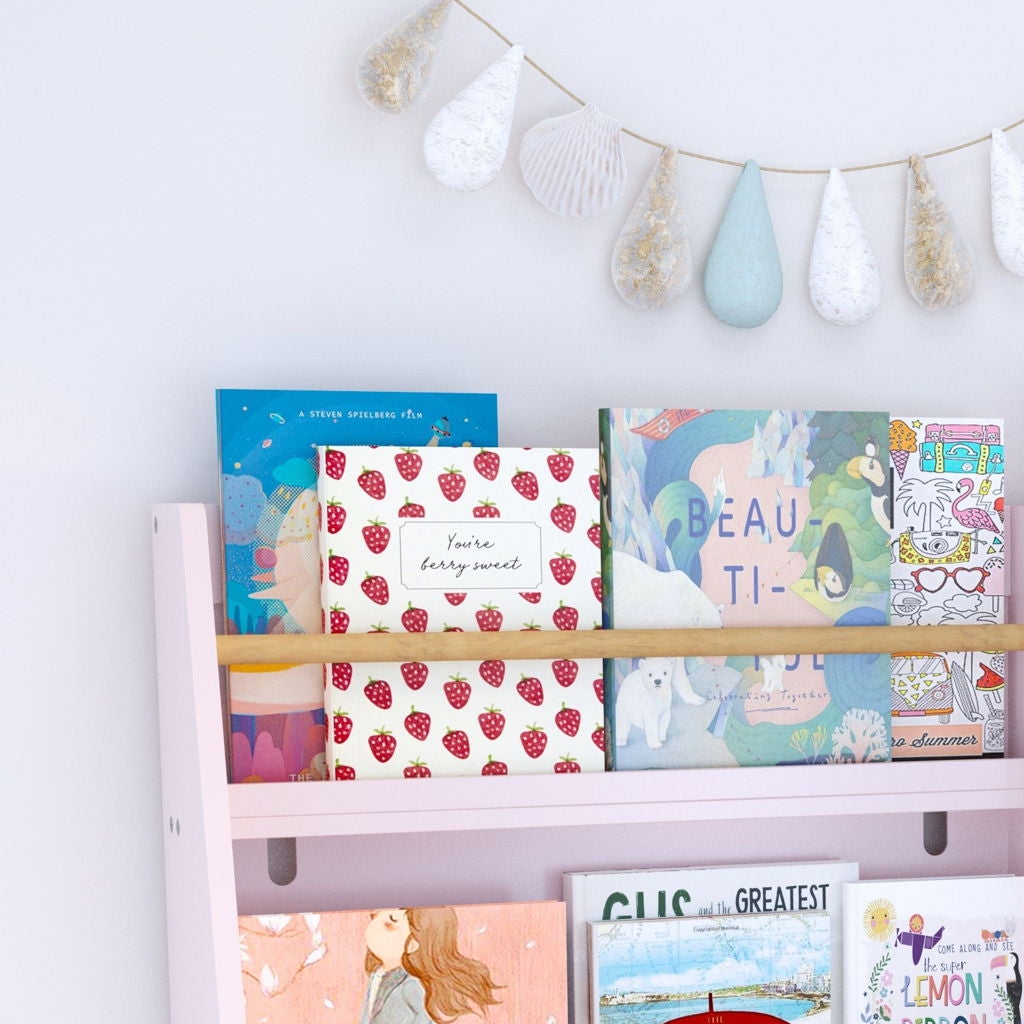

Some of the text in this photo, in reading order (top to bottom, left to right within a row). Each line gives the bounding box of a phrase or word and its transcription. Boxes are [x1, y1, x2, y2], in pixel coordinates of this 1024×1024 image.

[299, 410, 423, 419] A STEVEN SPIELBERG FILM
[687, 498, 823, 539] BEAU-
[447, 533, 495, 551] You're
[421, 556, 522, 578] berry sweet
[723, 565, 786, 605] TI-
[705, 690, 829, 703] Celebrating Together
[909, 732, 978, 748] Summer
[698, 902, 714, 916] and
[717, 901, 731, 915] the
[735, 884, 829, 913] GREATEST
[938, 941, 1014, 954] COME ALONG AND SEE
[924, 957, 966, 974] the super
[900, 972, 983, 1008] LEMON
